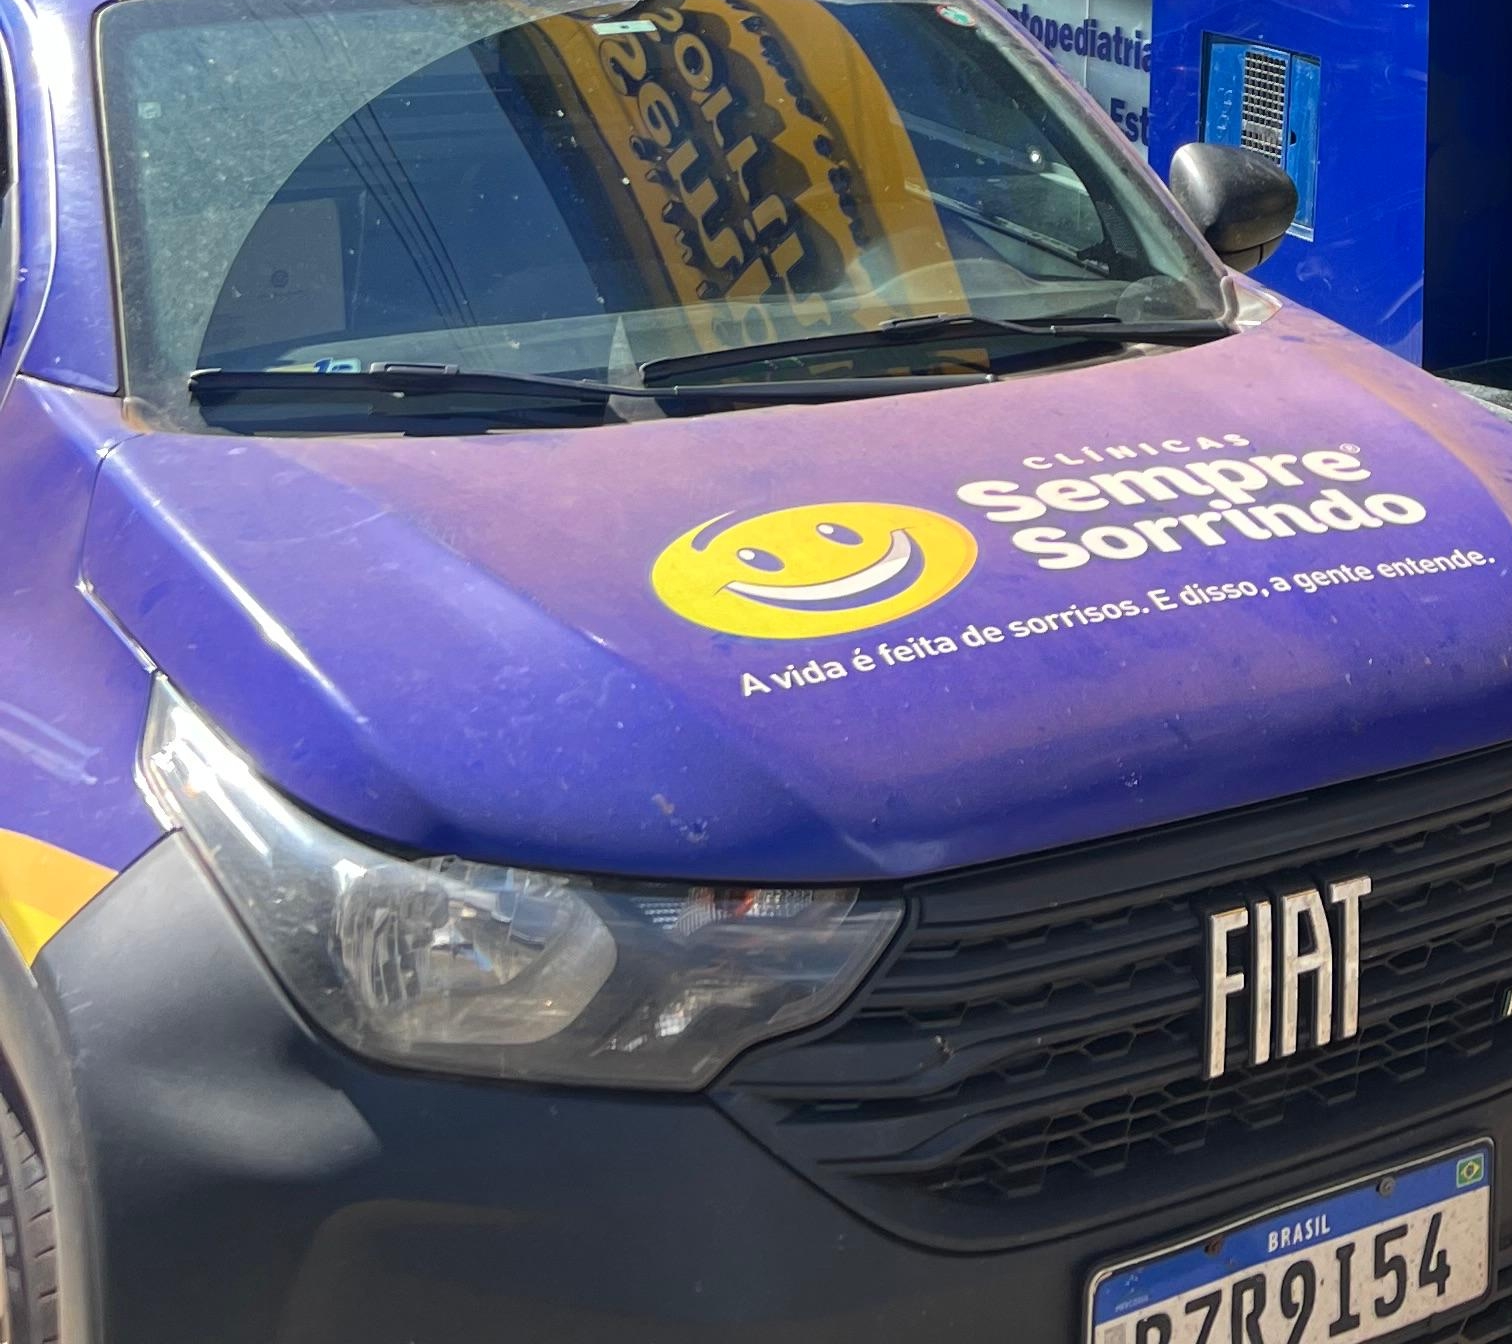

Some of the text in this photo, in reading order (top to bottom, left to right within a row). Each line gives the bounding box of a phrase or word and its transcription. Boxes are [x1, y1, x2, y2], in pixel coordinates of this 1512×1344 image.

[956, 449, 1372, 523] Sempre
[1022, 432, 1251, 472] CLÍNICAS
[1012, 488, 1427, 571] Sorrindo
[739, 548, 1497, 698] A vida é feita de sorrisos. E disso, a gente entende.
[1207, 875, 1372, 1080] FIAT
[1267, 1213, 1331, 1254] BRASIL
